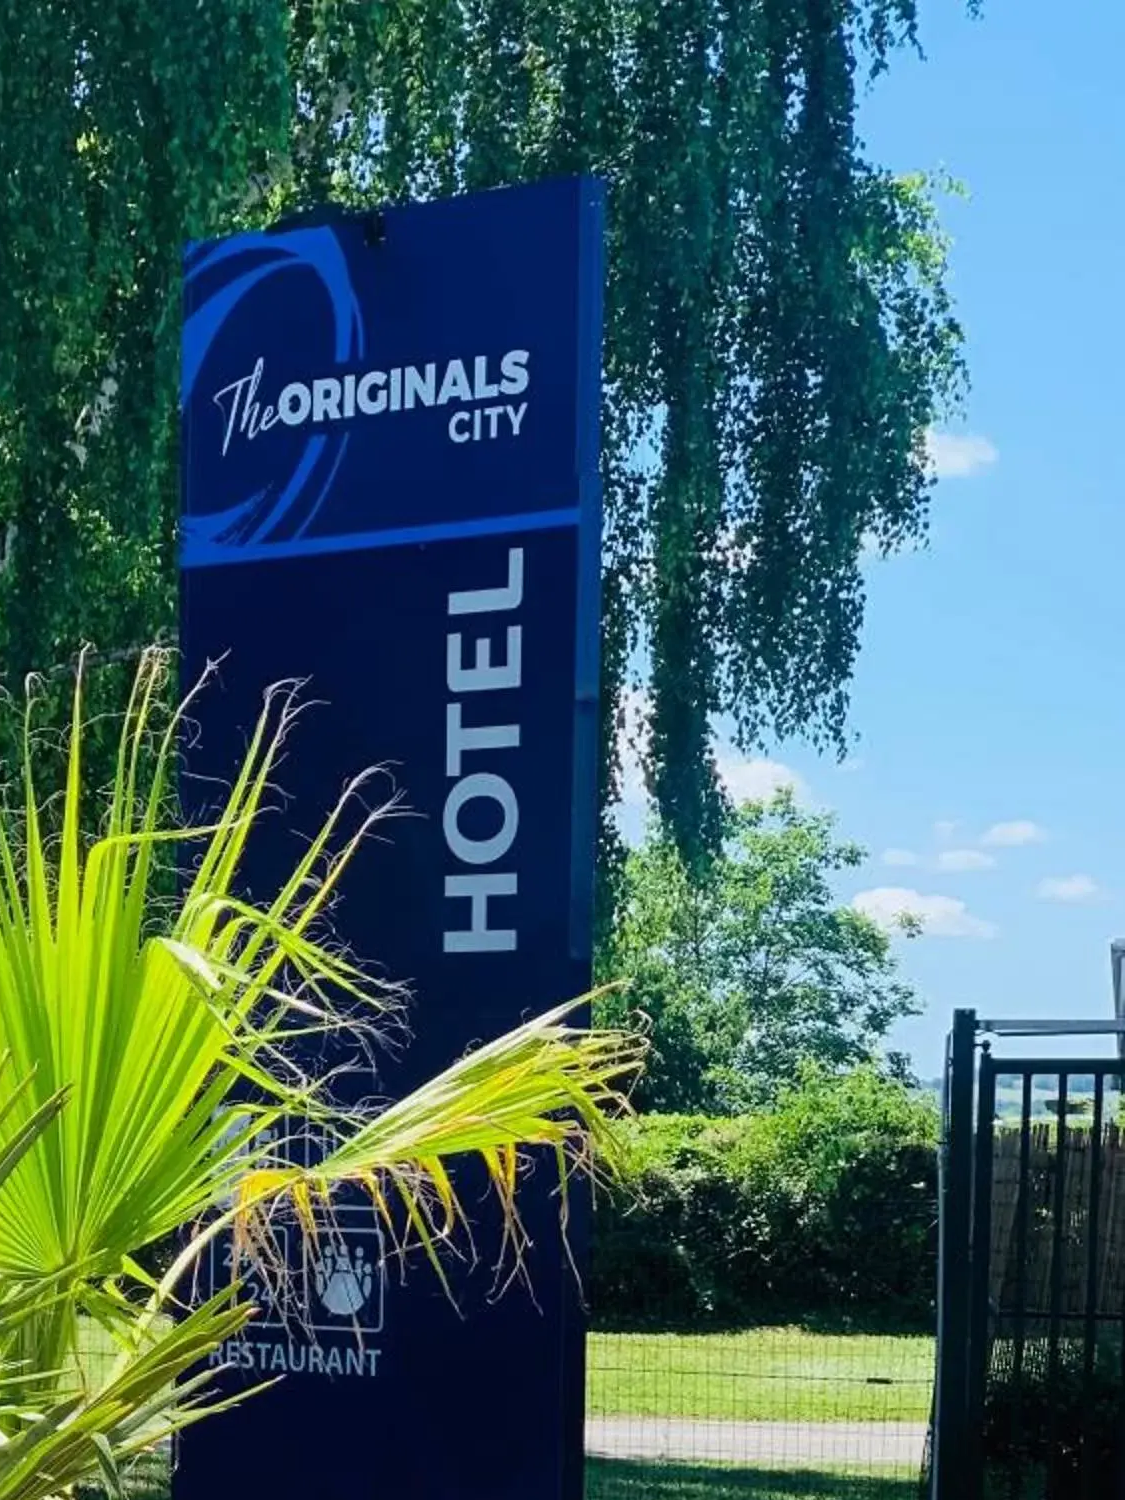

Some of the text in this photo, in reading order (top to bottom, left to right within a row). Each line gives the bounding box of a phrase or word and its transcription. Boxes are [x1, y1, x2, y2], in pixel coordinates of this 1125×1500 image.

[213, 350, 530, 456] The ORIGINALS
[449, 403, 529, 442] CITY
[443, 547, 523, 953] HOTEL
